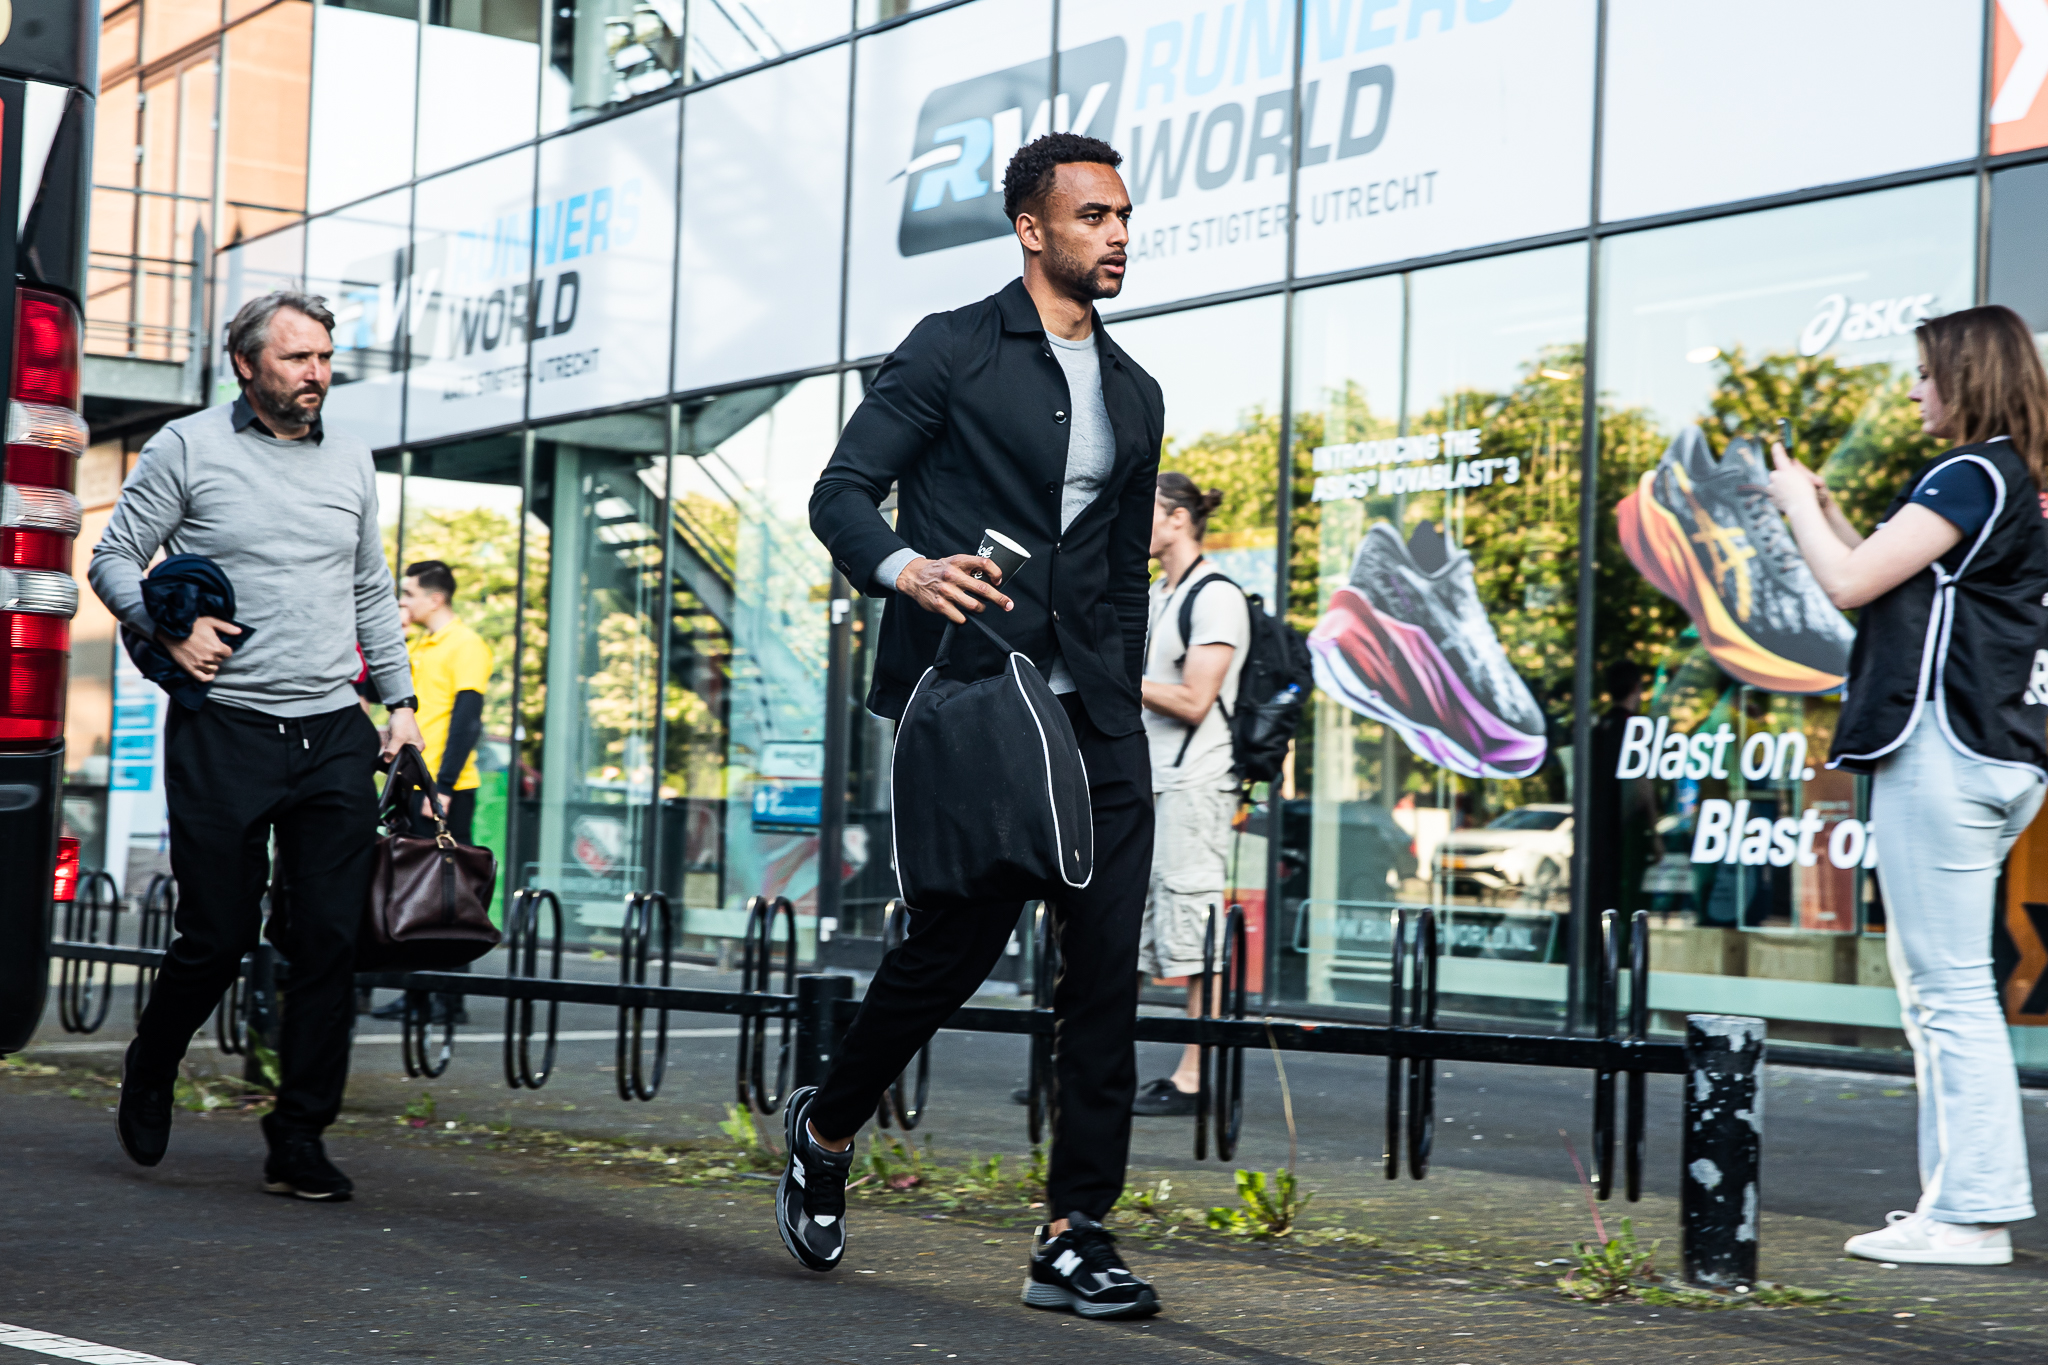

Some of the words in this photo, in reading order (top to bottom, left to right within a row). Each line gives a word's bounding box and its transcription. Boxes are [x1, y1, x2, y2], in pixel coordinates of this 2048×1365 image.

[1130, 64, 1395, 205] WORLD
[453, 178, 643, 288] RUNNERS
[1188, 203, 1289, 252] STIGTER
[1312, 170, 1439, 225] UTRECHT
[448, 270, 581, 359] WORLD
[1312, 433, 1440, 472] INTRODUCING
[1442, 427, 1482, 458] THE
[1503, 456, 1520, 484] 3
[1615, 715, 1736, 781] Blast
[1740, 730, 1815, 782] on.
[1690, 798, 1824, 867] Blast
